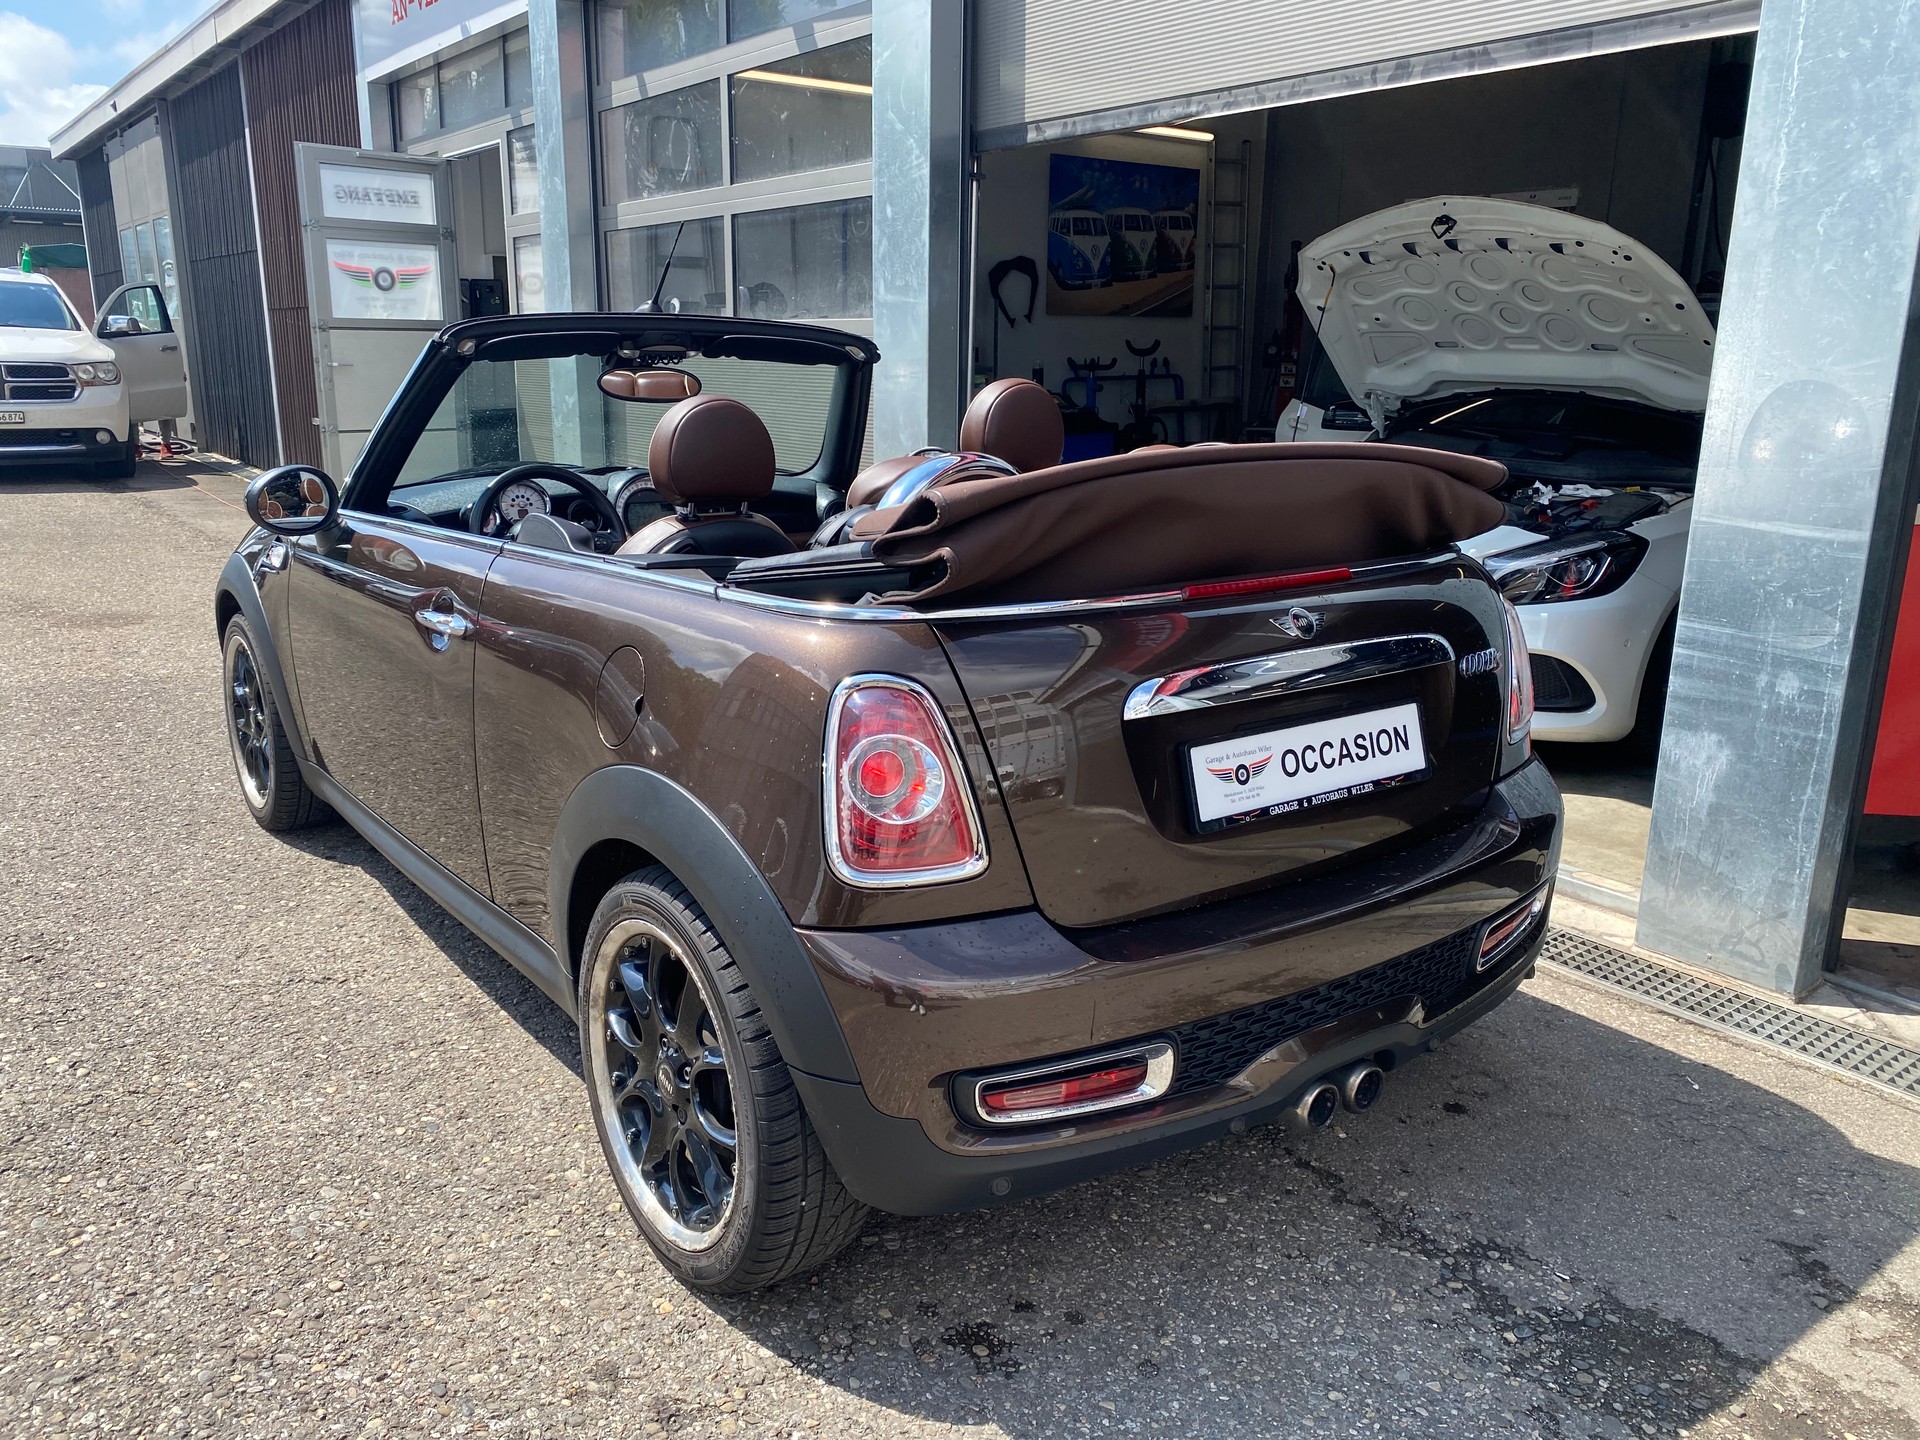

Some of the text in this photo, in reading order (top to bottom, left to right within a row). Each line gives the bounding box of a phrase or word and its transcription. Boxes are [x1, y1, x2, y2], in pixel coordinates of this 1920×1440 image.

[1205, 745, 1272, 764] Garage & Autohaus Wiler
[1280, 724, 1410, 778] OCCASION
[1269, 783, 1374, 815] GARAGE & AUTOHAUS WILER
